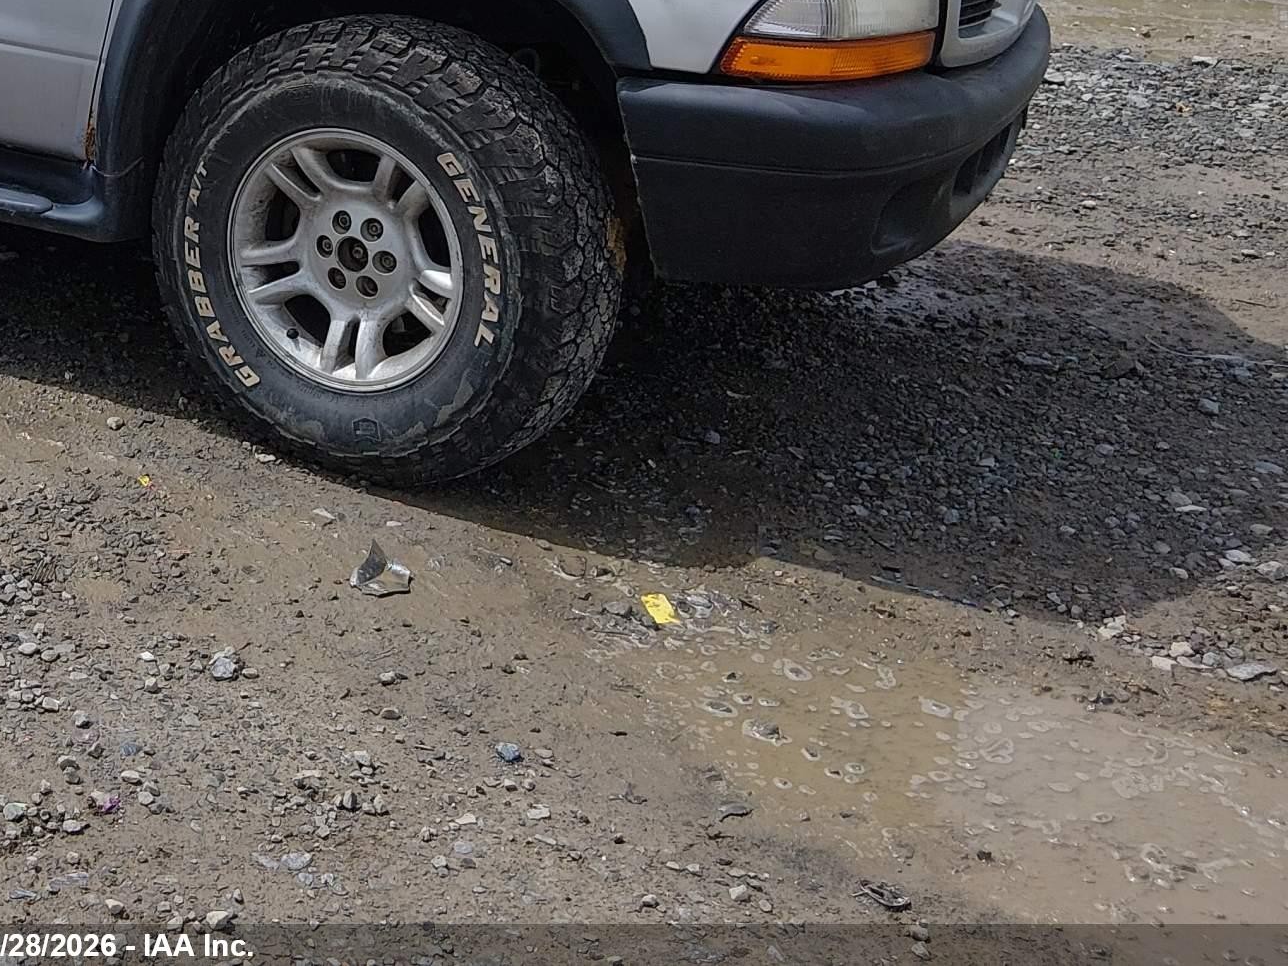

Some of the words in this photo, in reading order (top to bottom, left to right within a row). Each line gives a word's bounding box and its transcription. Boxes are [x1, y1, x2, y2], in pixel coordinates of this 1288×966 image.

[189, 161, 208, 207] A/T
[437, 151, 501, 347] GENERAL
[185, 215, 260, 388] GRABBER
